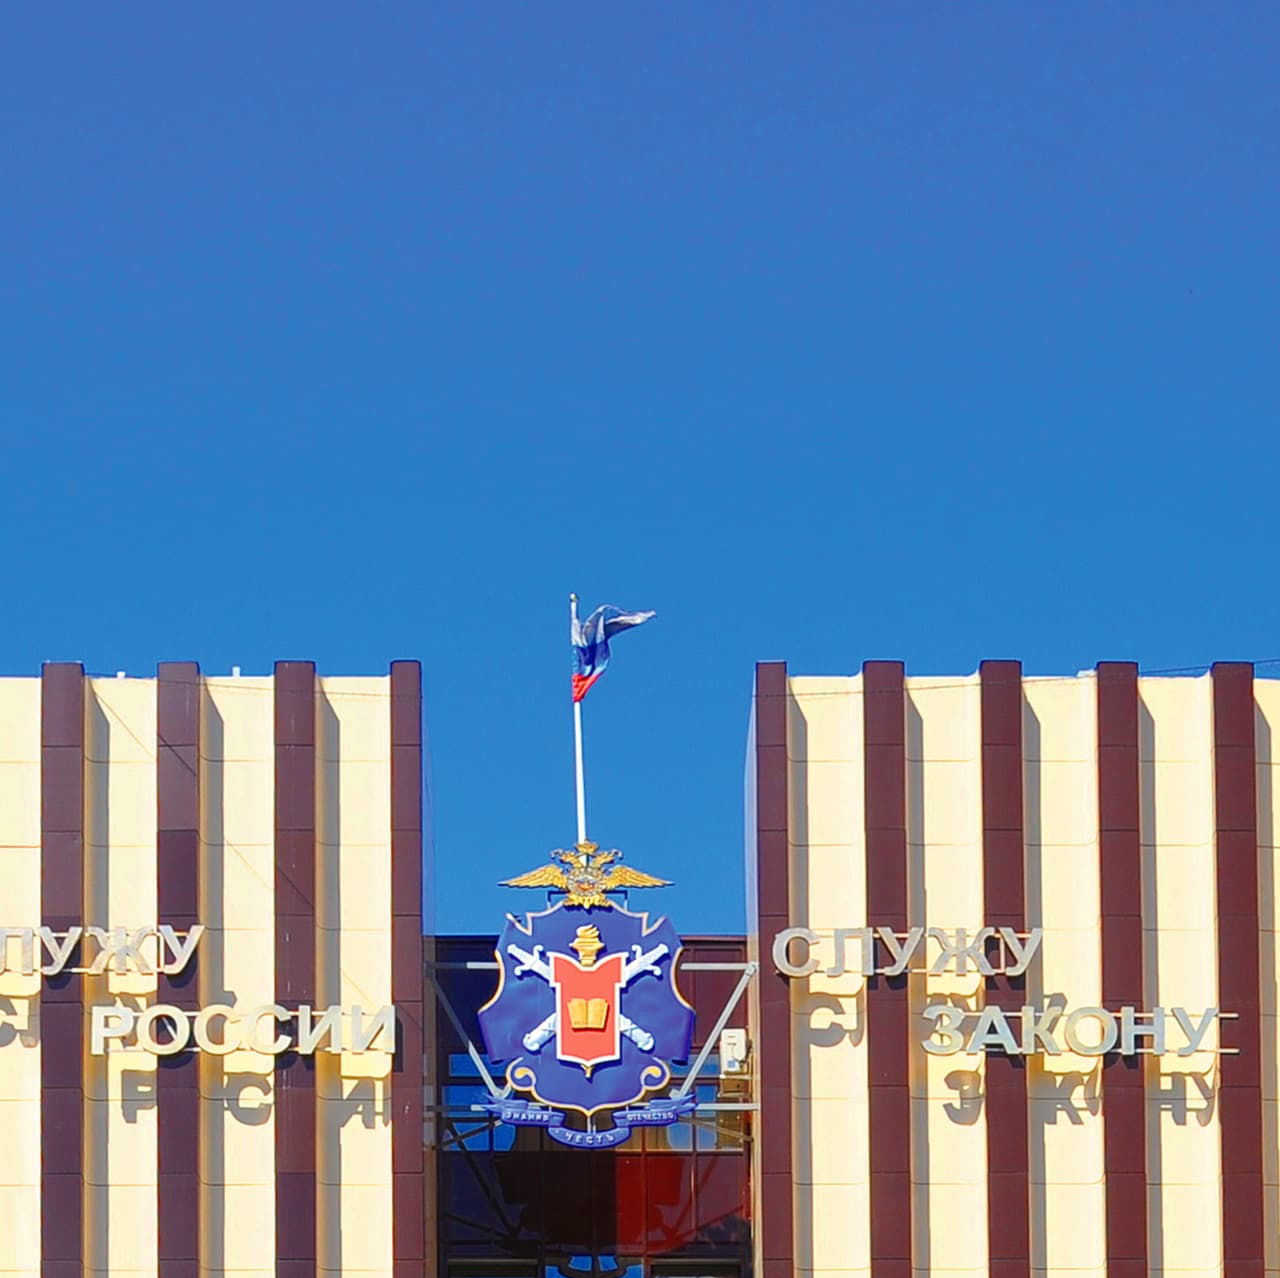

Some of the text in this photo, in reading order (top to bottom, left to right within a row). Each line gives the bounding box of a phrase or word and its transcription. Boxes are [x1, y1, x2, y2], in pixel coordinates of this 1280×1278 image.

[772, 926, 1042, 977] СЛУЖУ
[91, 1004, 395, 1055] РОССИИ
[921, 1005, 1217, 1056] ЗАКОНУ
[565, 1132, 615, 1144] ЧЕСТЬ
